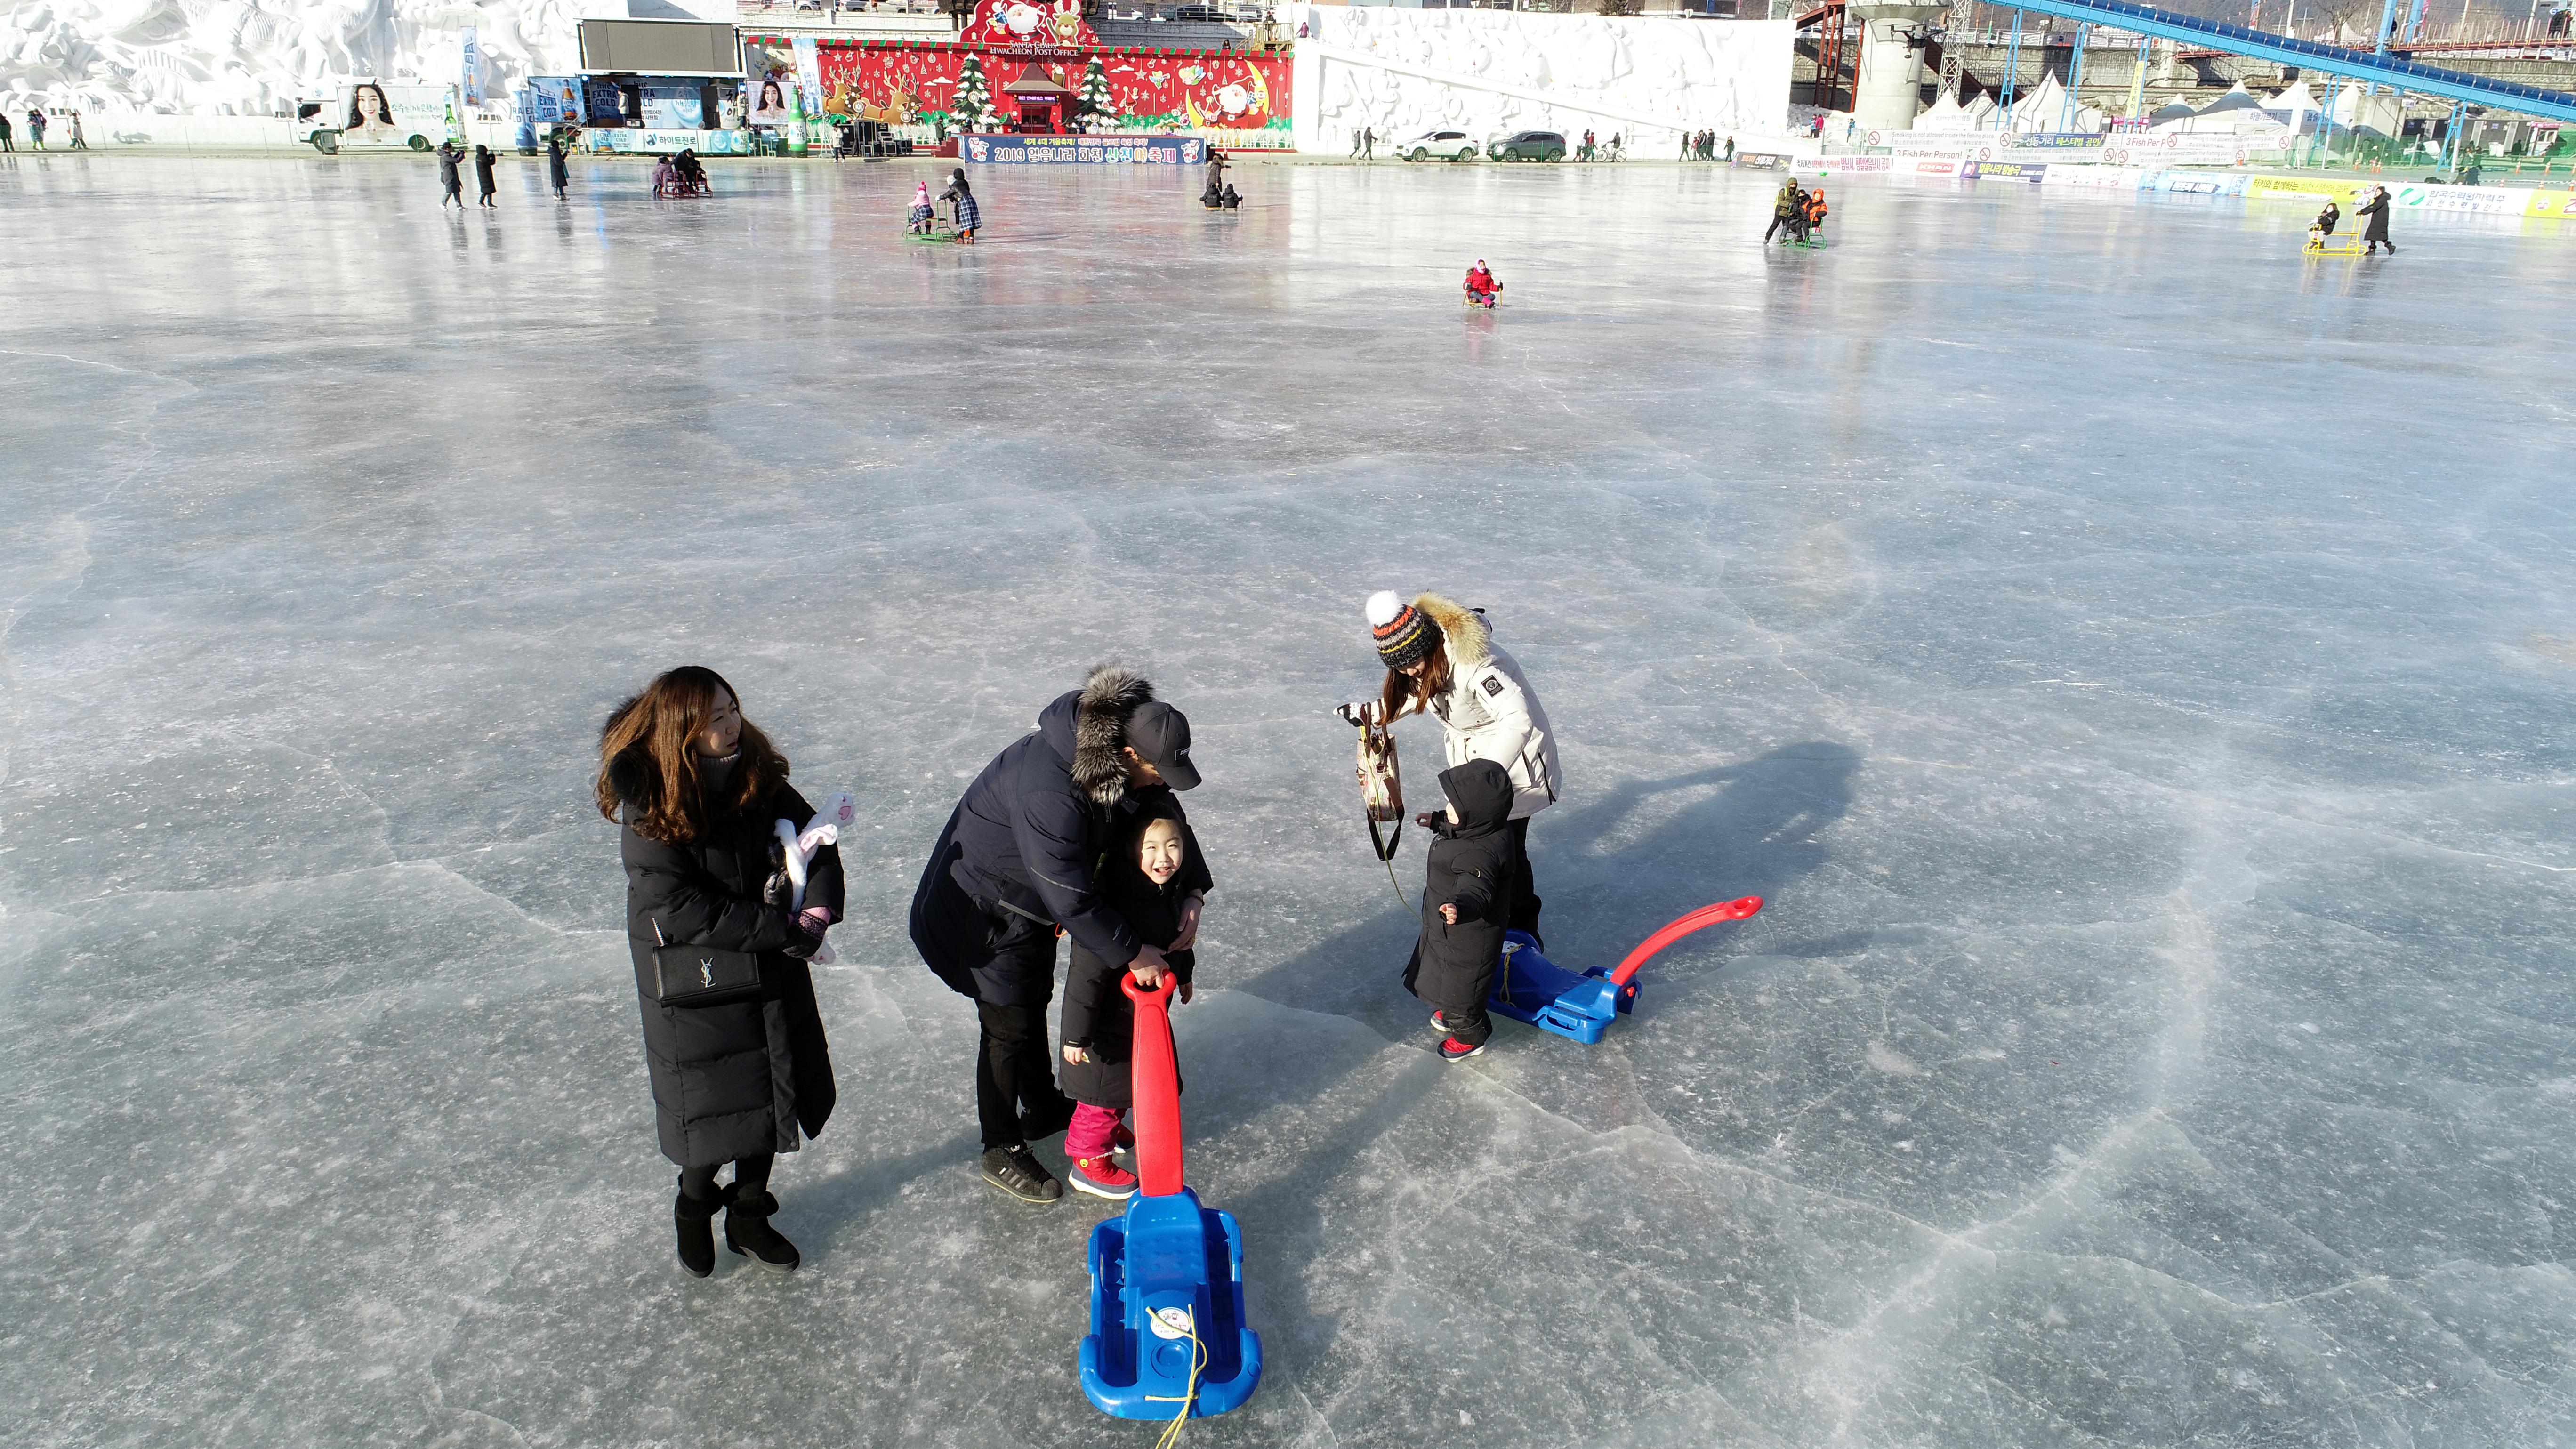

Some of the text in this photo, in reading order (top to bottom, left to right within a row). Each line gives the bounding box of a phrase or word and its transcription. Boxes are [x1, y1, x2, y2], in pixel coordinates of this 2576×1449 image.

[593, 89, 617, 99] EXTRA
[596, 98, 616, 106] COLD
[543, 107, 557, 118] COLD
[2307, 113, 2330, 122] 봅슬이
[660, 136, 697, 145] 하이트진로
[2056, 137, 2084, 146] 페스티벌
[2126, 138, 2131, 146] 3
[2132, 138, 2146, 146] Fish
[995, 147, 1025, 161] 2019
[1027, 147, 1076, 162] 얼음나라
[1078, 147, 1103, 162] 화천
[1934, 151, 1962, 159] Person!
[1978, 163, 2002, 175] 얼음나라
[2002, 165, 2021, 176] 방송국
[2273, 180, 2299, 191] 함께하는
